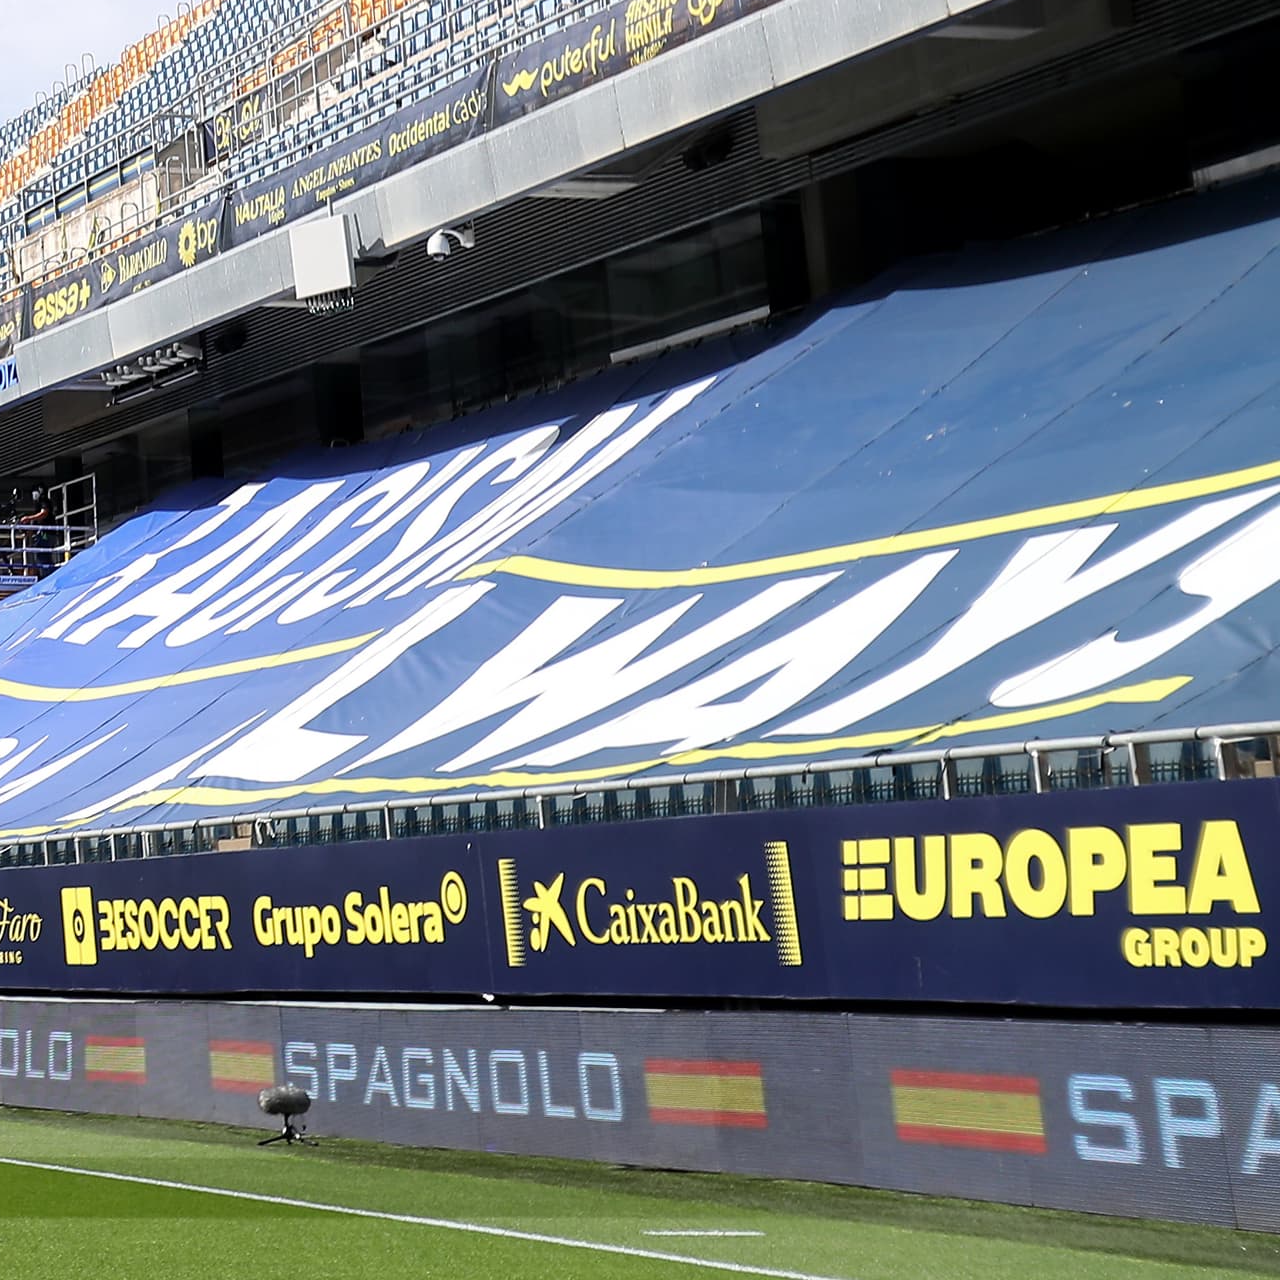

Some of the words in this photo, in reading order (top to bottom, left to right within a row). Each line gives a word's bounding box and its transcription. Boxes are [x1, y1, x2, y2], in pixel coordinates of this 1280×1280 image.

[625, 8, 673, 52] MANILA
[234, 186, 285, 226] NAUTALIA
[389, 111, 451, 157] Occidental
[197, 217, 217, 253] bp
[842, 820, 1261, 921] EUROPEA
[99, 895, 233, 952] BESOCCER
[253, 895, 342, 958] Grupo
[344, 886, 445, 945] Solera
[575, 873, 772, 945] CaixaBank
[1123, 927, 1266, 969] GROUP
[284, 1041, 623, 1122] SPAGNOLO
